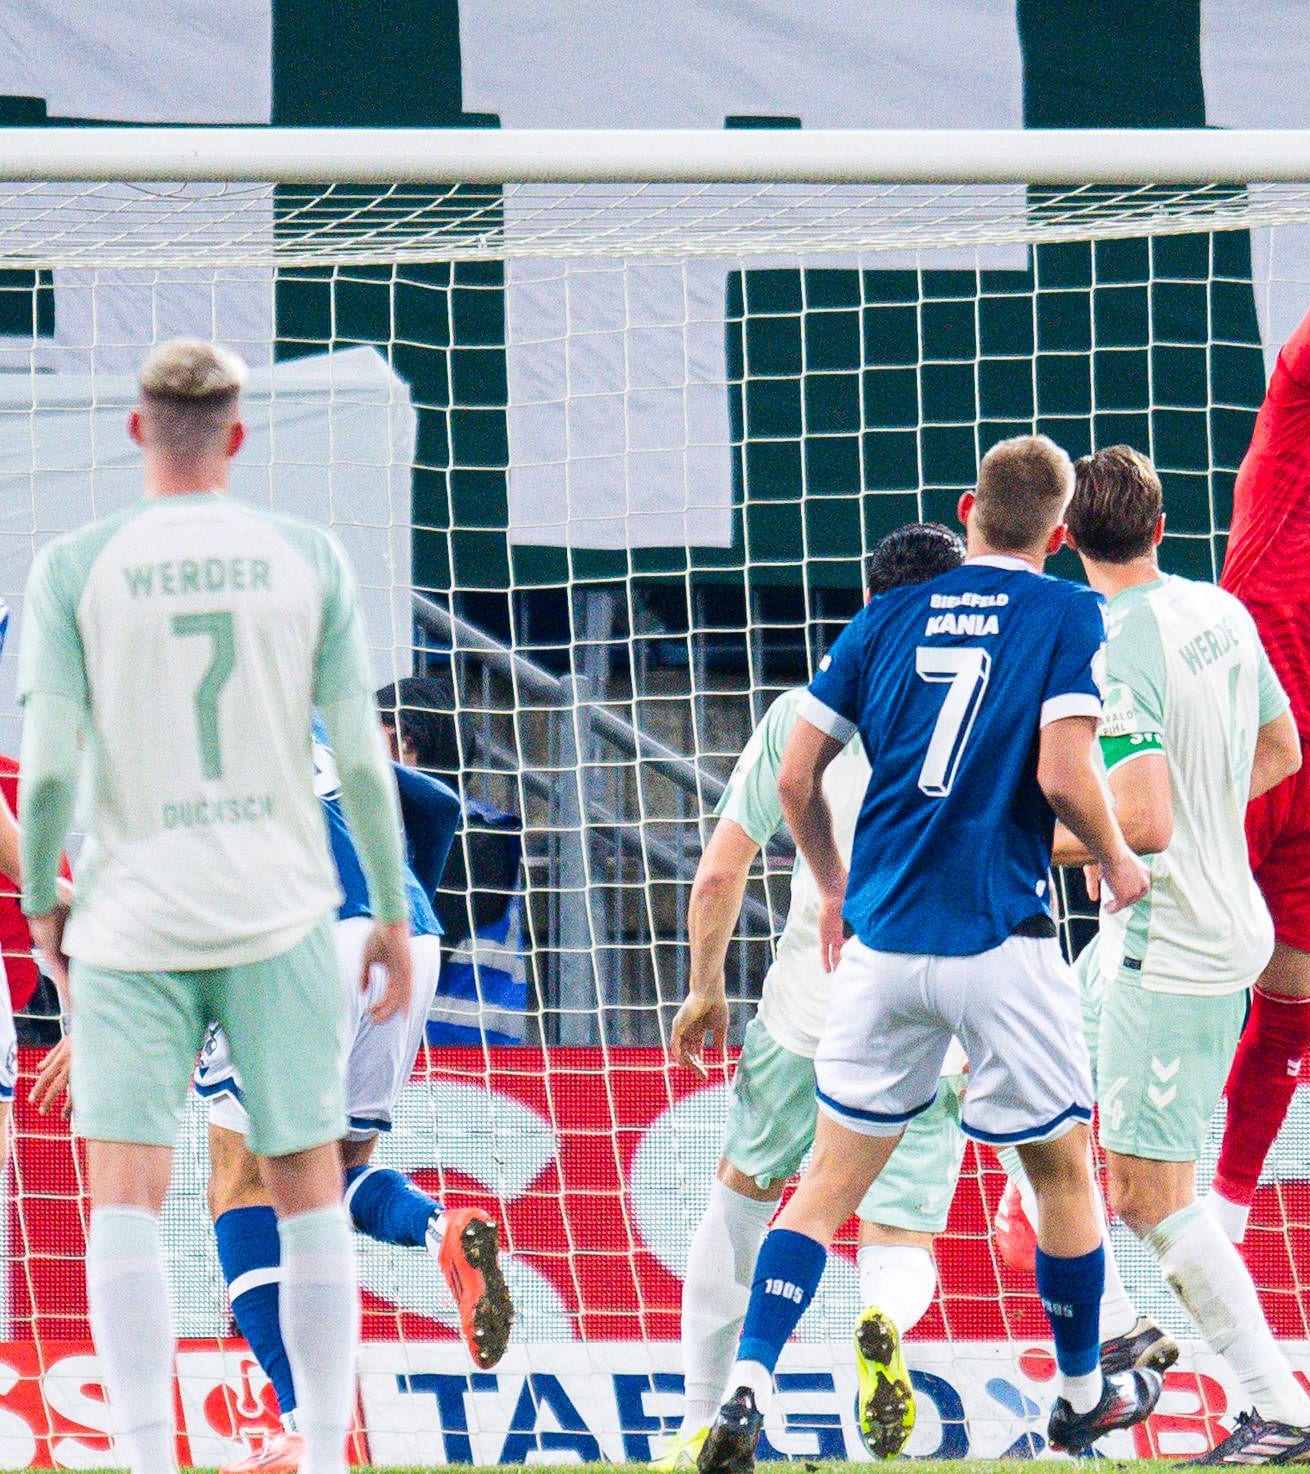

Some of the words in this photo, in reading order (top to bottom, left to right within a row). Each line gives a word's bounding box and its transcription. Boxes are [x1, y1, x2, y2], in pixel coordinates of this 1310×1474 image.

[122, 558, 271, 599] WERDER
[924, 612, 1000, 637] KANIA
[170, 611, 236, 780] 7
[915, 646, 992, 798] 7
[1103, 1076, 1129, 1132] 4
[765, 1278, 804, 1304] 1905
